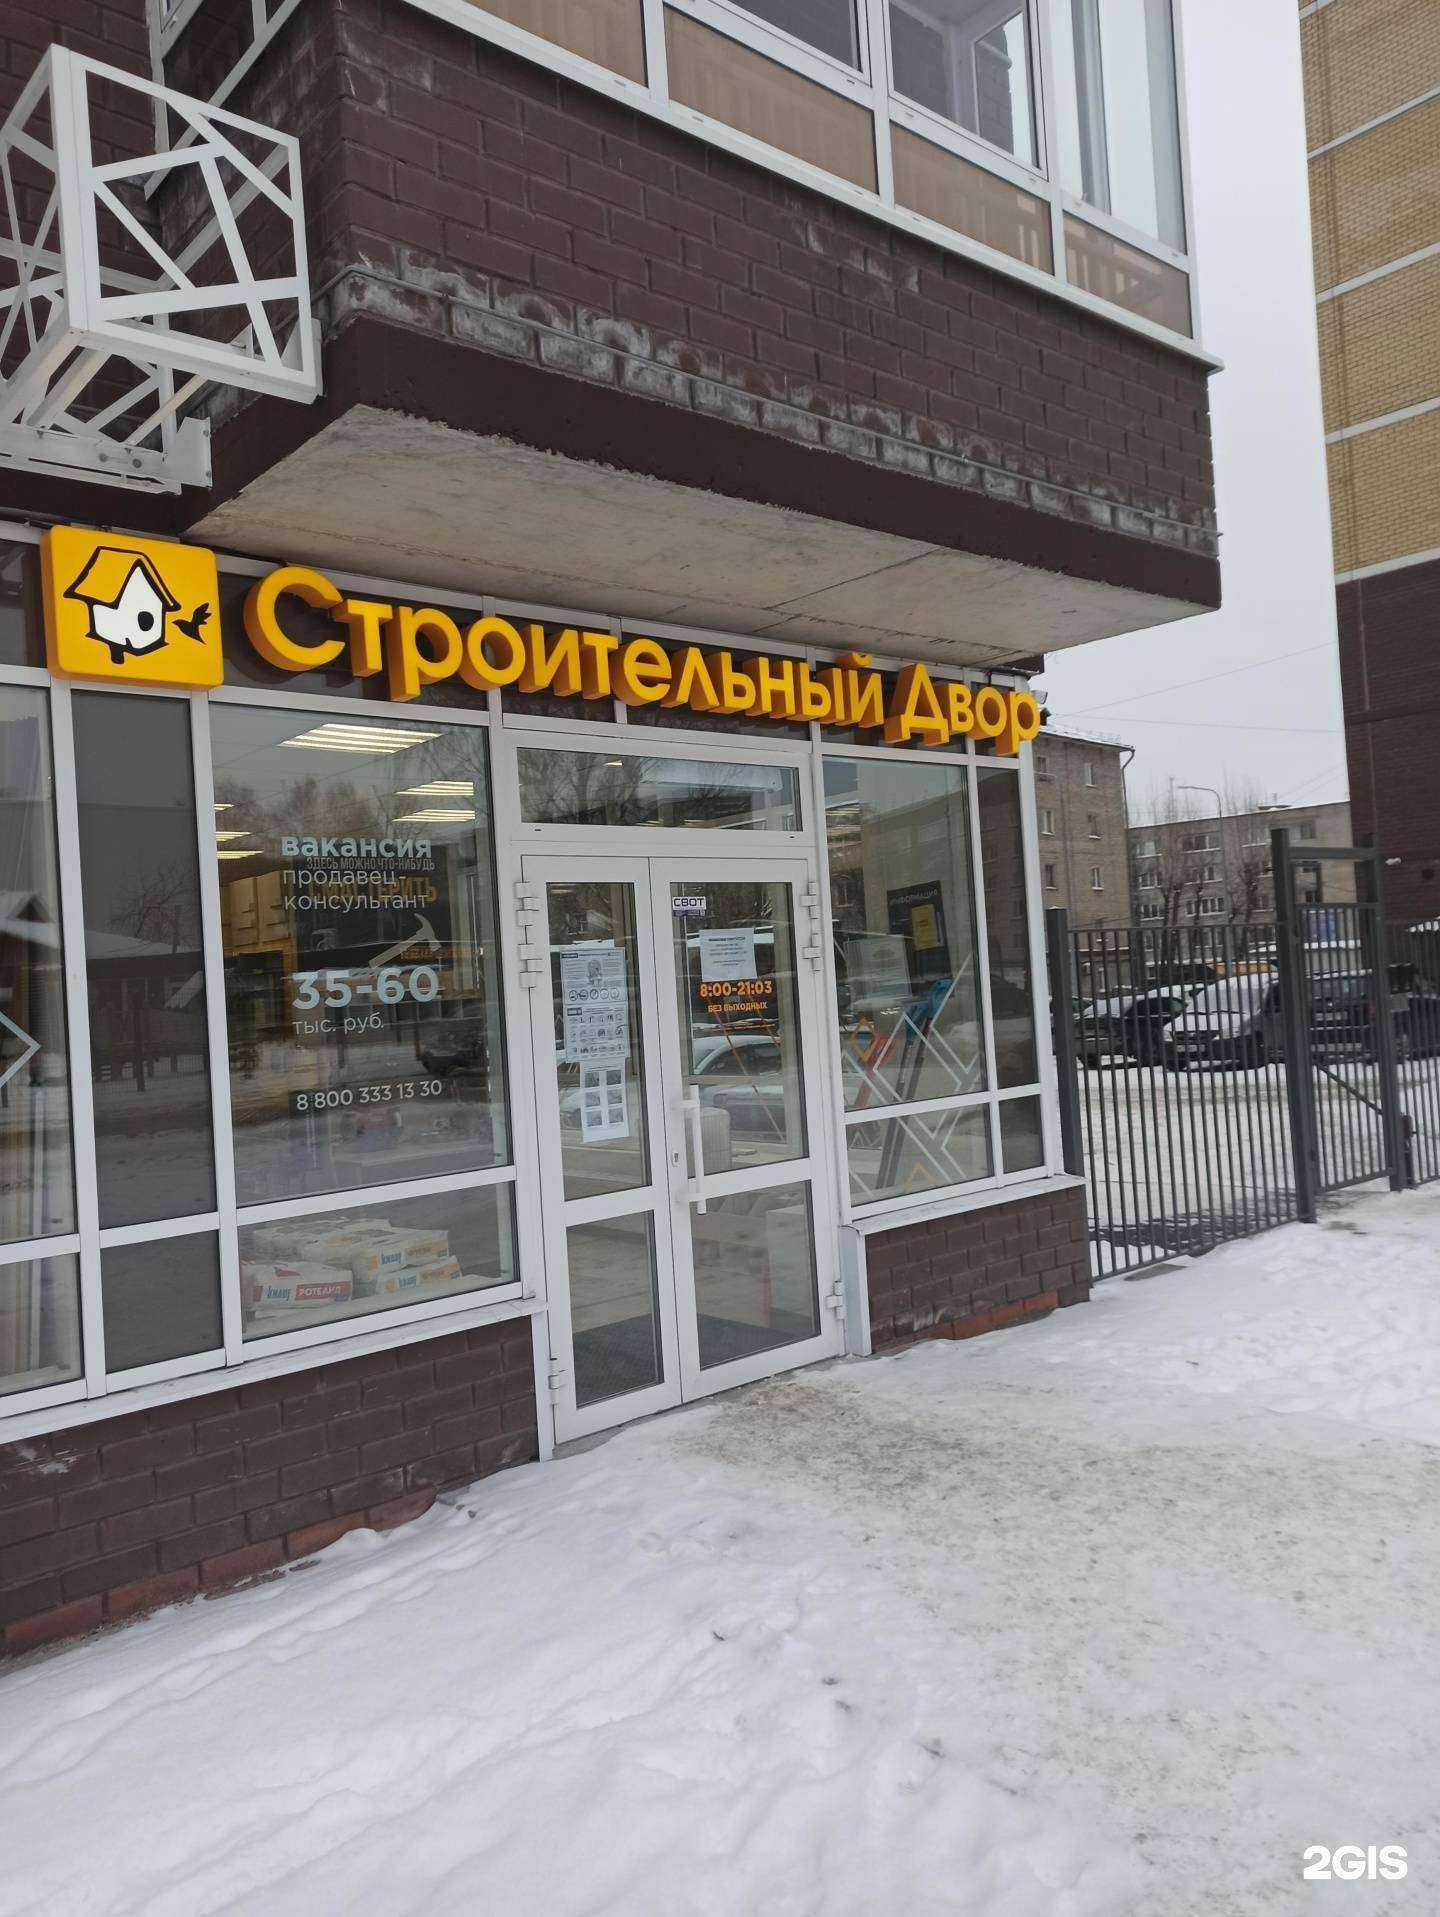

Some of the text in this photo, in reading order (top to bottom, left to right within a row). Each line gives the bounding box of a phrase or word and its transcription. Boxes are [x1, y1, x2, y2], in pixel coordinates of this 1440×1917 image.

[244, 566, 1041, 756] Строительный Двор
[281, 835, 433, 859] вакансия
[283, 870, 407, 889] продавец-
[284, 894, 431, 914] консультант
[291, 965, 440, 1010] 35-60
[700, 980, 773, 998] 8:00-21:03
[708, 1001, 768, 1014] БЕЗ ВЫХОДНЫХ
[292, 1011, 385, 1035] тыс. руб.
[296, 1079, 443, 1111] 8 800 333 13 30
